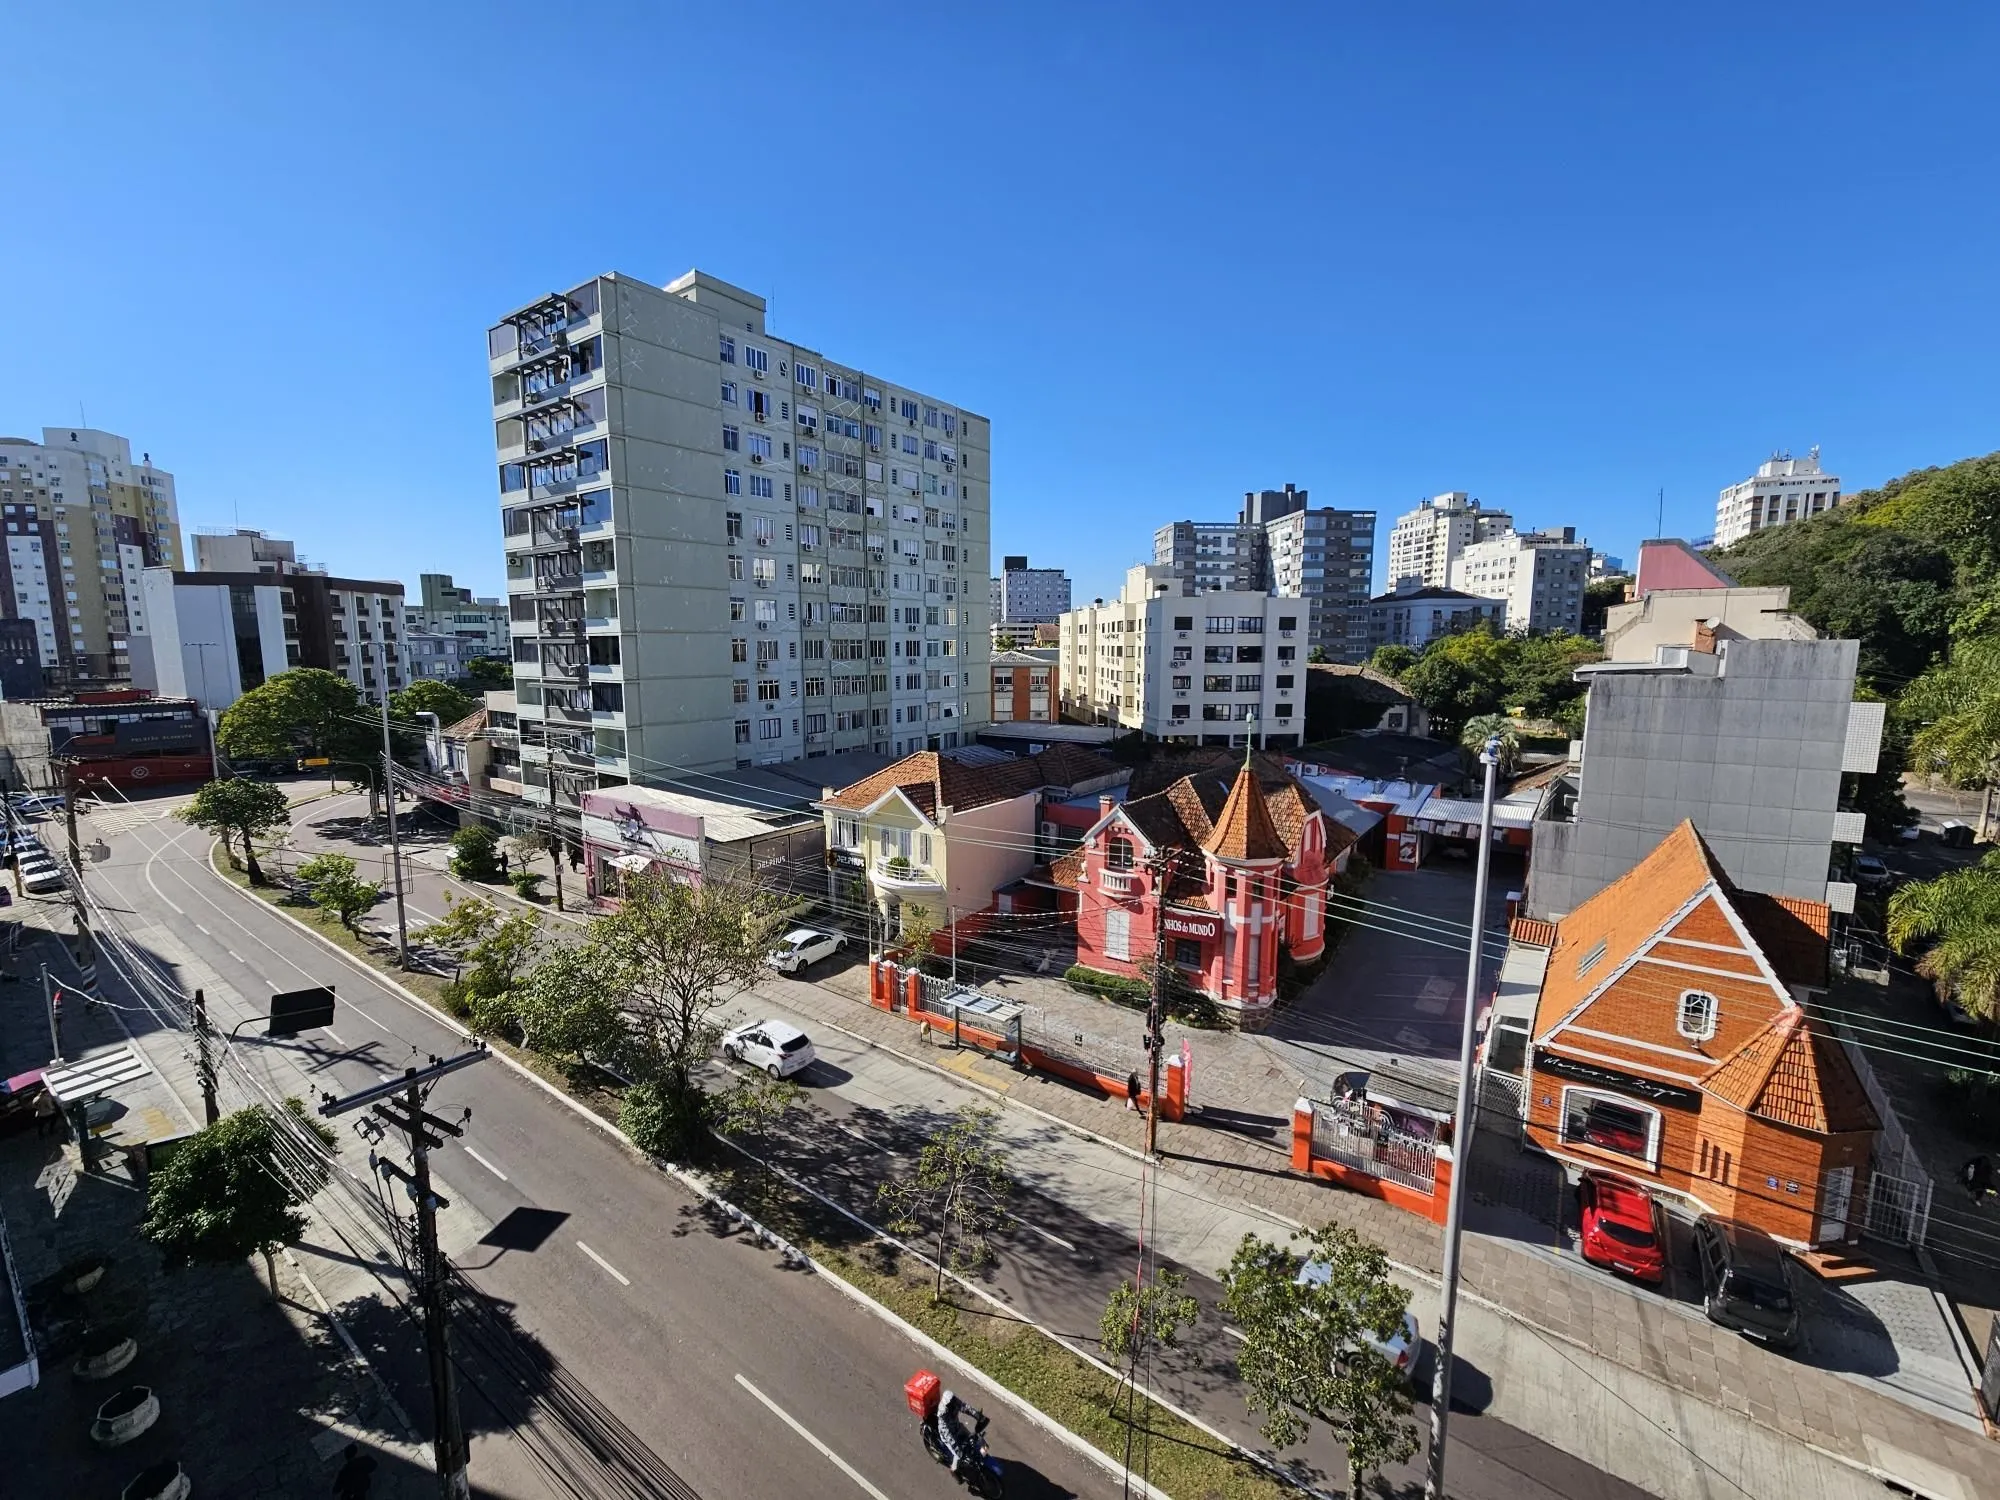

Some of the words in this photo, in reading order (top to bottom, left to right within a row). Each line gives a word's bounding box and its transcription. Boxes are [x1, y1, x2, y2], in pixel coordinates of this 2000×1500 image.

[1164, 919, 1182, 932] NHOS
[1182, 922, 1189, 933] do
[1189, 922, 1216, 937] MUNDO
